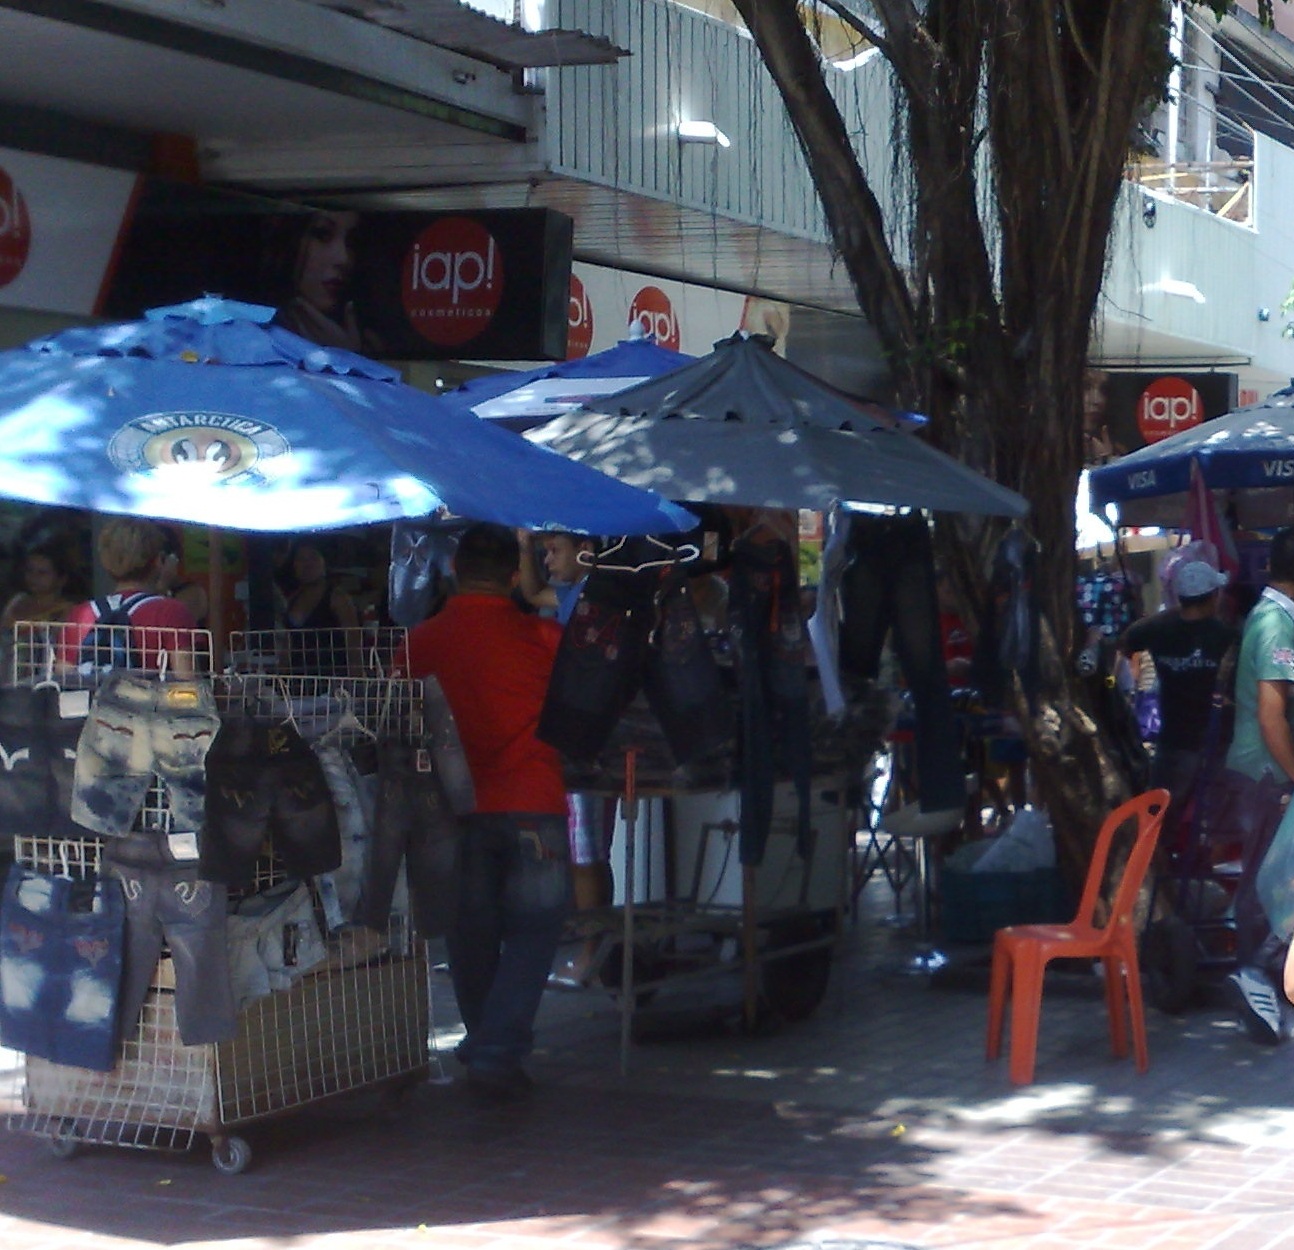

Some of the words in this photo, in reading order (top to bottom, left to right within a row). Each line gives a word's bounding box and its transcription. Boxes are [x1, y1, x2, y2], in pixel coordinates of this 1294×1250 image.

[412, 235, 496, 304] iap!
[1143, 388, 1197, 428] iap!
[140, 414, 262, 435] ANTARCTICA
[1128, 470, 1156, 490] VISA
